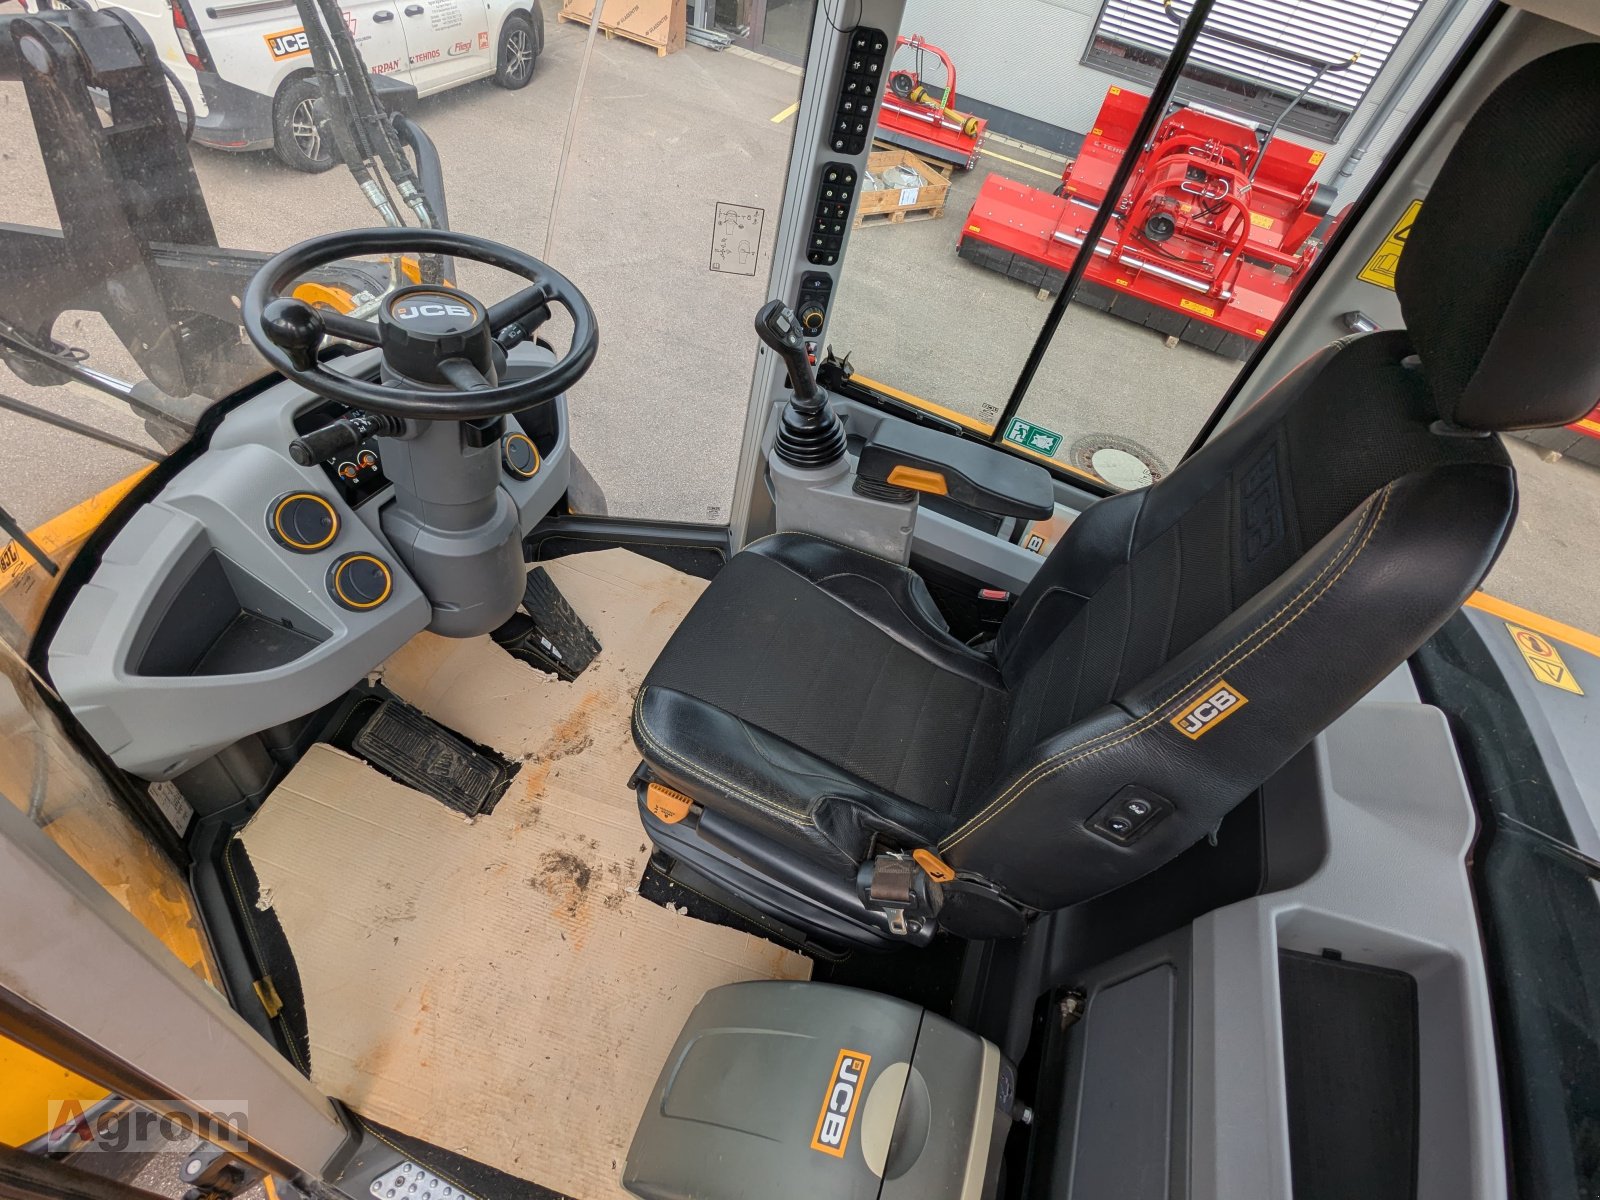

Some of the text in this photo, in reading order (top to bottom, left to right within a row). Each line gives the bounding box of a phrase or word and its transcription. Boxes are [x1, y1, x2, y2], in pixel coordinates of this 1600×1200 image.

[272, 33, 310, 56] JCB
[415, 49, 441, 63] TEHNOS
[398, 304, 471, 320] JCB
[1182, 689, 1237, 733] JCB
[820, 1058, 859, 1145] JCB
